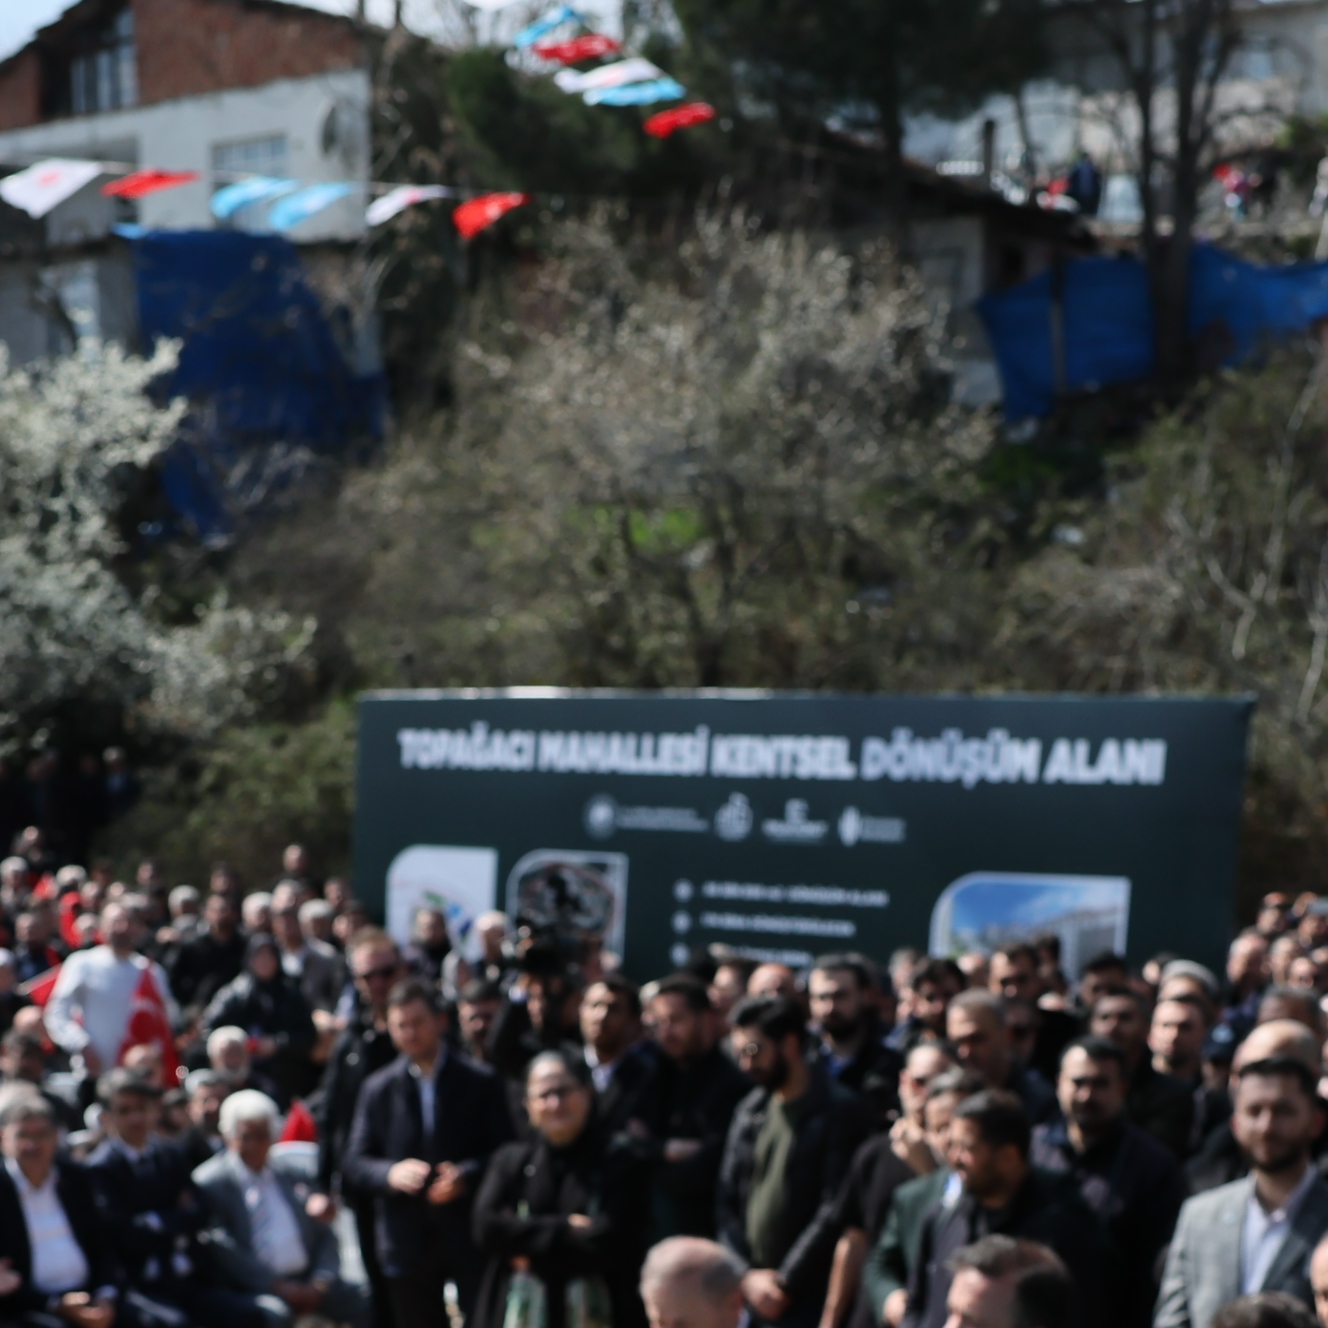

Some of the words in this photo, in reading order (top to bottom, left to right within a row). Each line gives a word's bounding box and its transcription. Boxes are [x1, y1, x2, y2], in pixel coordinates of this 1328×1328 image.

[711, 734, 857, 780] KENTSEL
[861, 727, 1042, 789] DÖNÜŞÜM
[1043, 738, 1167, 785] ALANI
